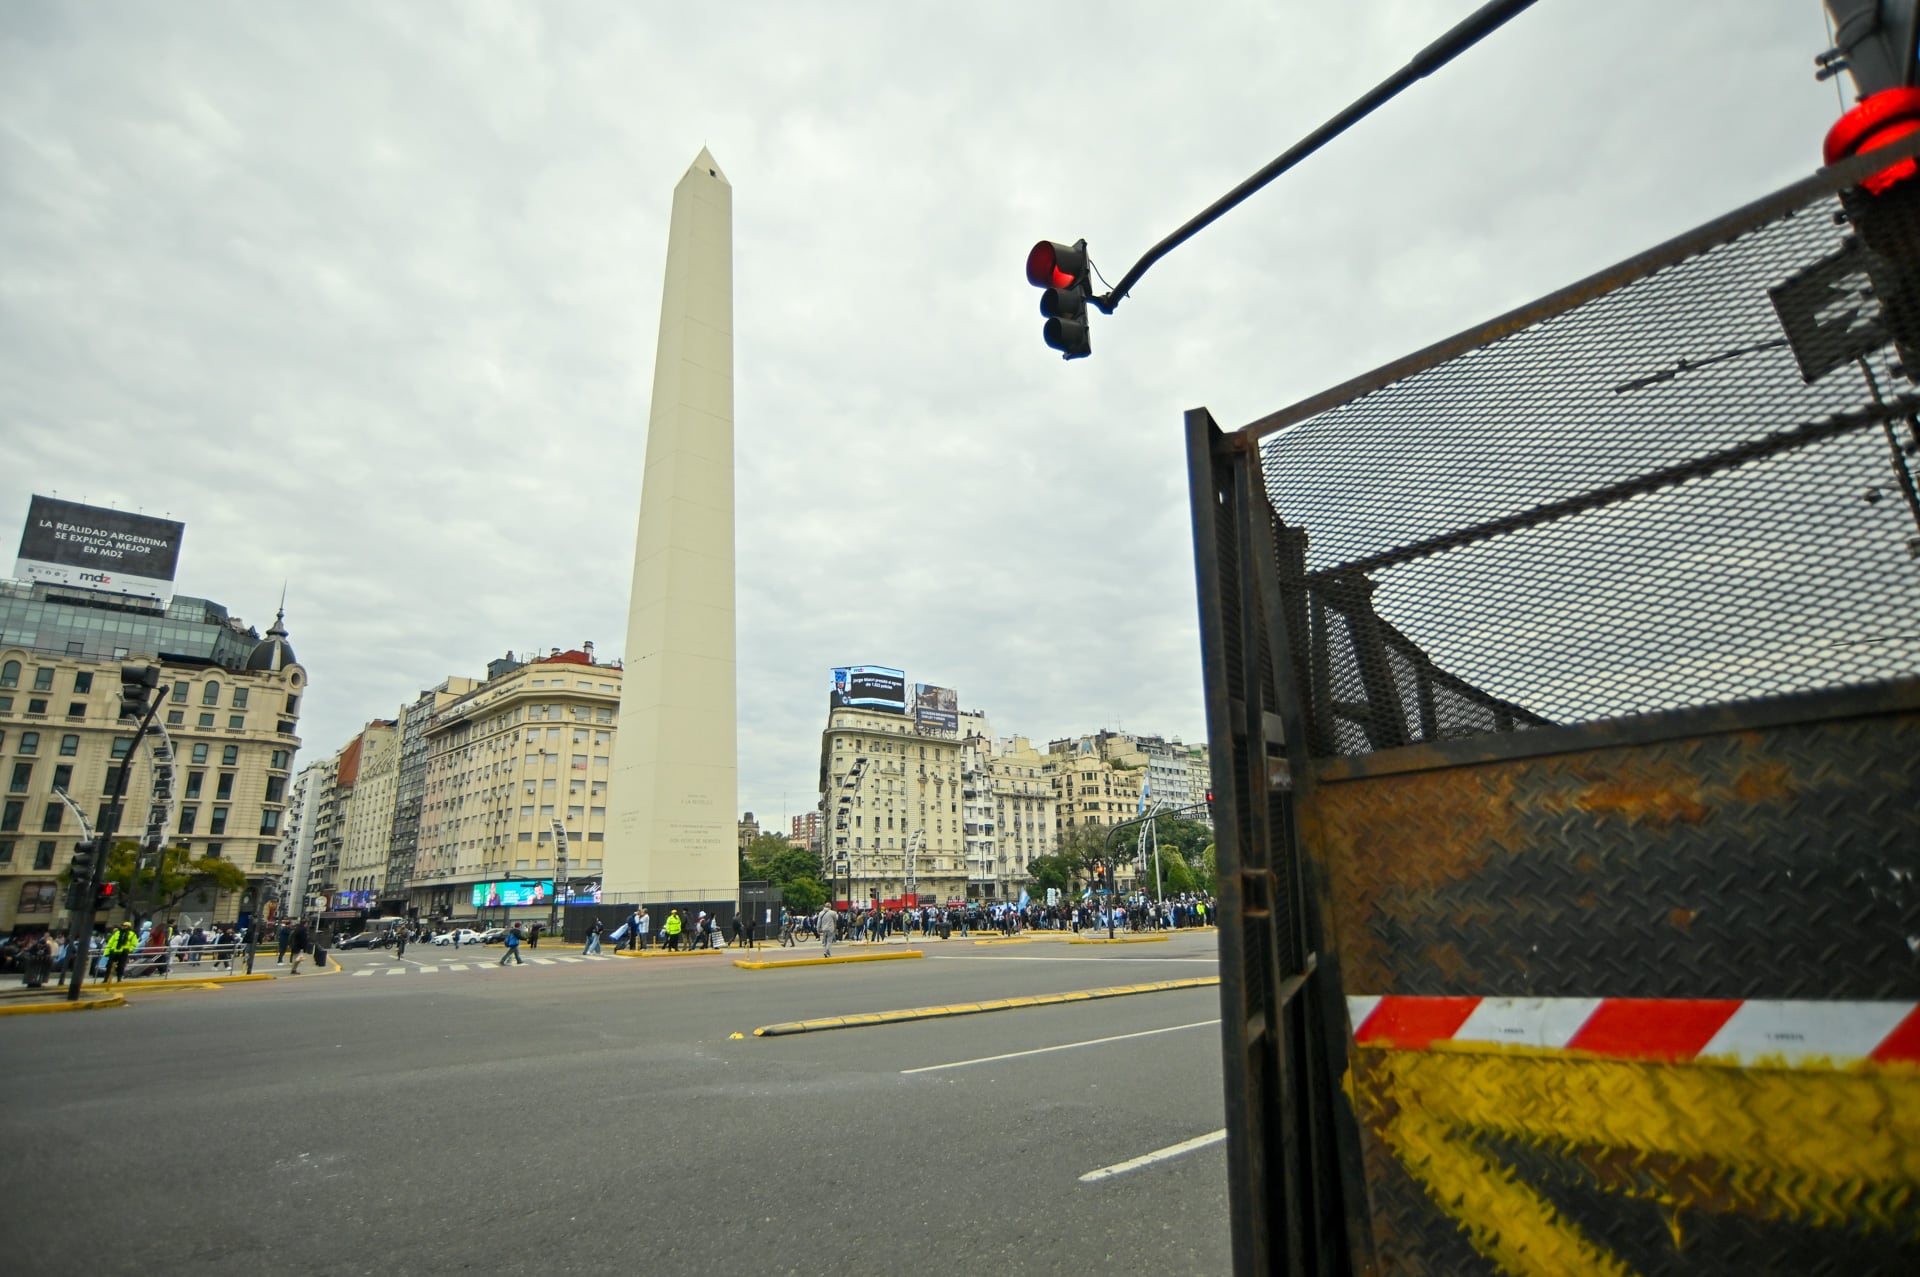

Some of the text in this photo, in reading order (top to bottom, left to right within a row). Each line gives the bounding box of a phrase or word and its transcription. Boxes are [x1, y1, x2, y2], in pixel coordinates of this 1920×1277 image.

[40, 520, 168, 548] LA REALIDAD ARGENTINA
[55, 532, 151, 554] SE EXPLICA MEJOR
[84, 546, 124, 559] EN MDZ
[80, 573, 111, 584] mdz
[1174, 813, 1205, 821] CORRIENTES
